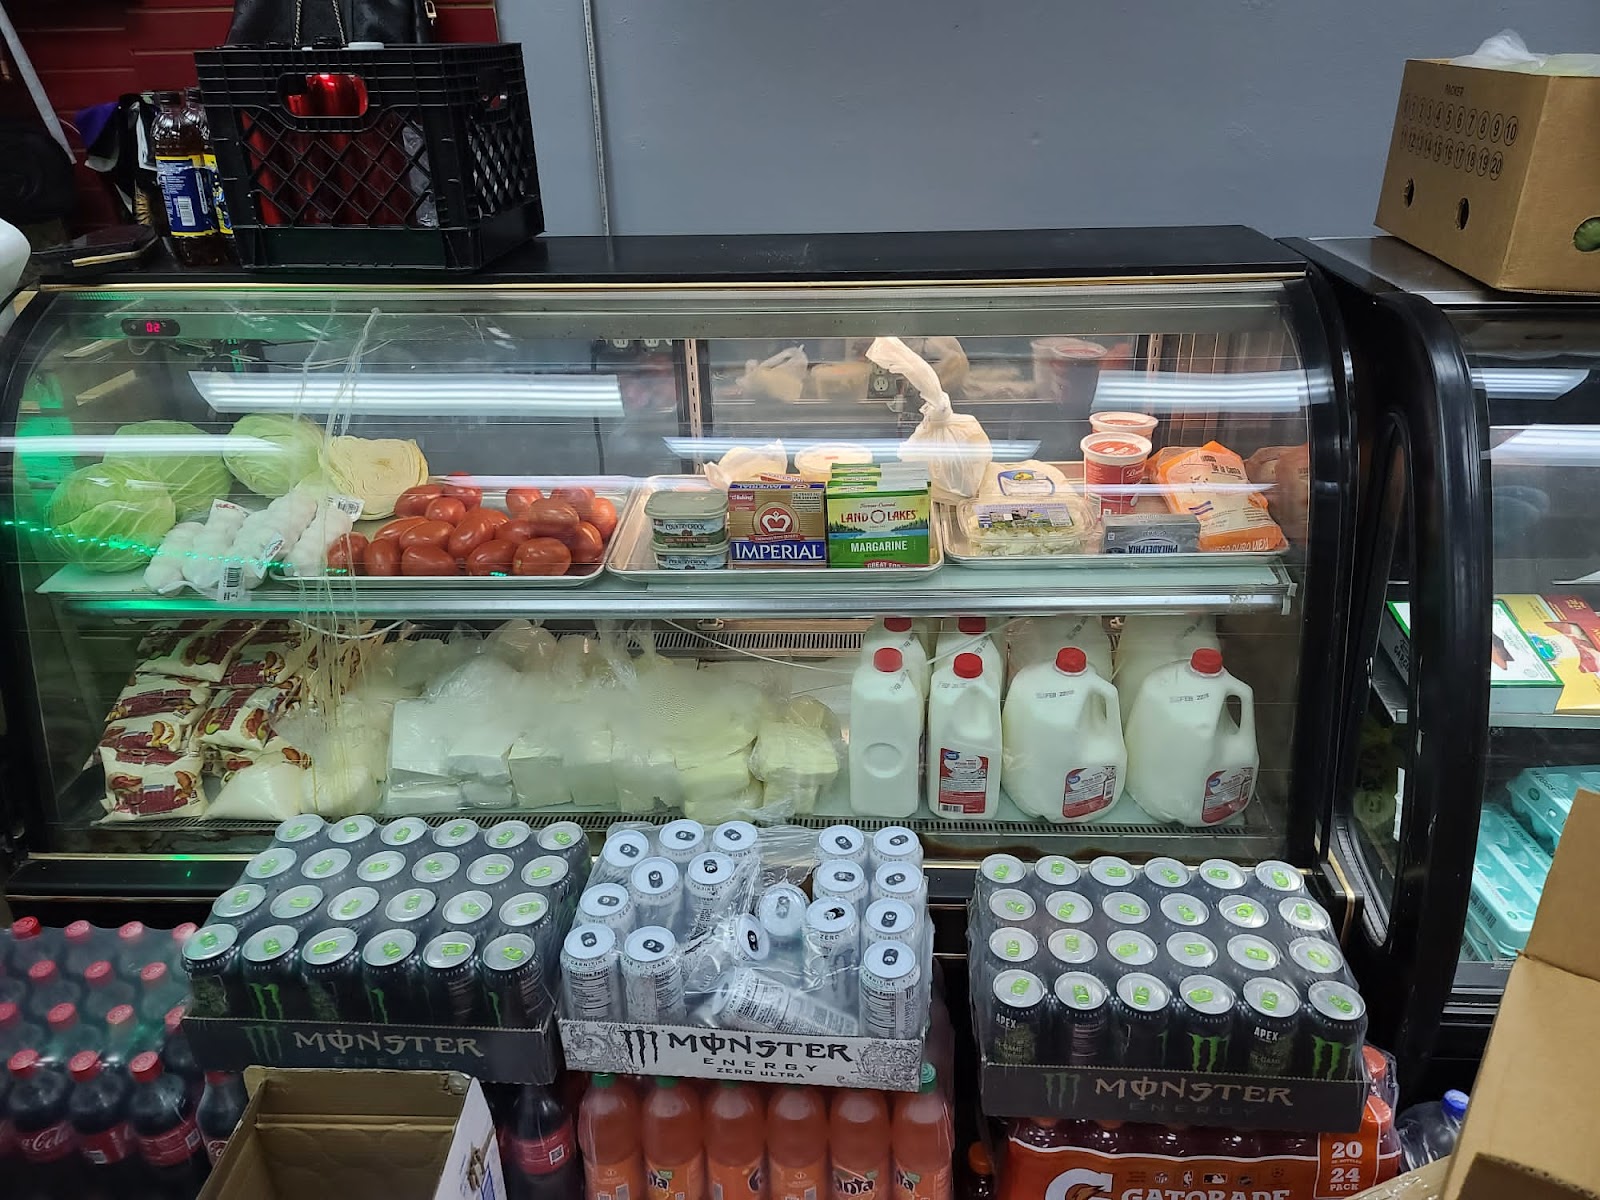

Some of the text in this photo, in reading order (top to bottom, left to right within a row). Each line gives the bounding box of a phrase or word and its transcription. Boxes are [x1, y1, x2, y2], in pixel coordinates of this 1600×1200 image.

[145, 321, 161, 333] 02
[840, 509, 918, 524] LAND O LAKES
[734, 542, 823, 560] IMPERIAL
[850, 540, 908, 553] MARGARINE
[1128, 544, 1178, 553] PHILADELPHIA
[995, 1013, 1017, 1029] APEX
[1254, 1026, 1280, 1041] APEX
[293, 1029, 485, 1058] MONSTER
[667, 1032, 854, 1062] MONSTER
[334, 1056, 453, 1069] ENERGY
[703, 1057, 819, 1072] ENERGY
[716, 1067, 805, 1079] ZERO ULTRA
[1095, 1075, 1294, 1107] MONSTER
[1129, 1101, 1257, 1117] ENERGY
[1331, 1140, 1363, 1159] 20
[1330, 1167, 1360, 1183] 24
[833, 1178, 876, 1195] anta
[1330, 1183, 1360, 1191] PACK
